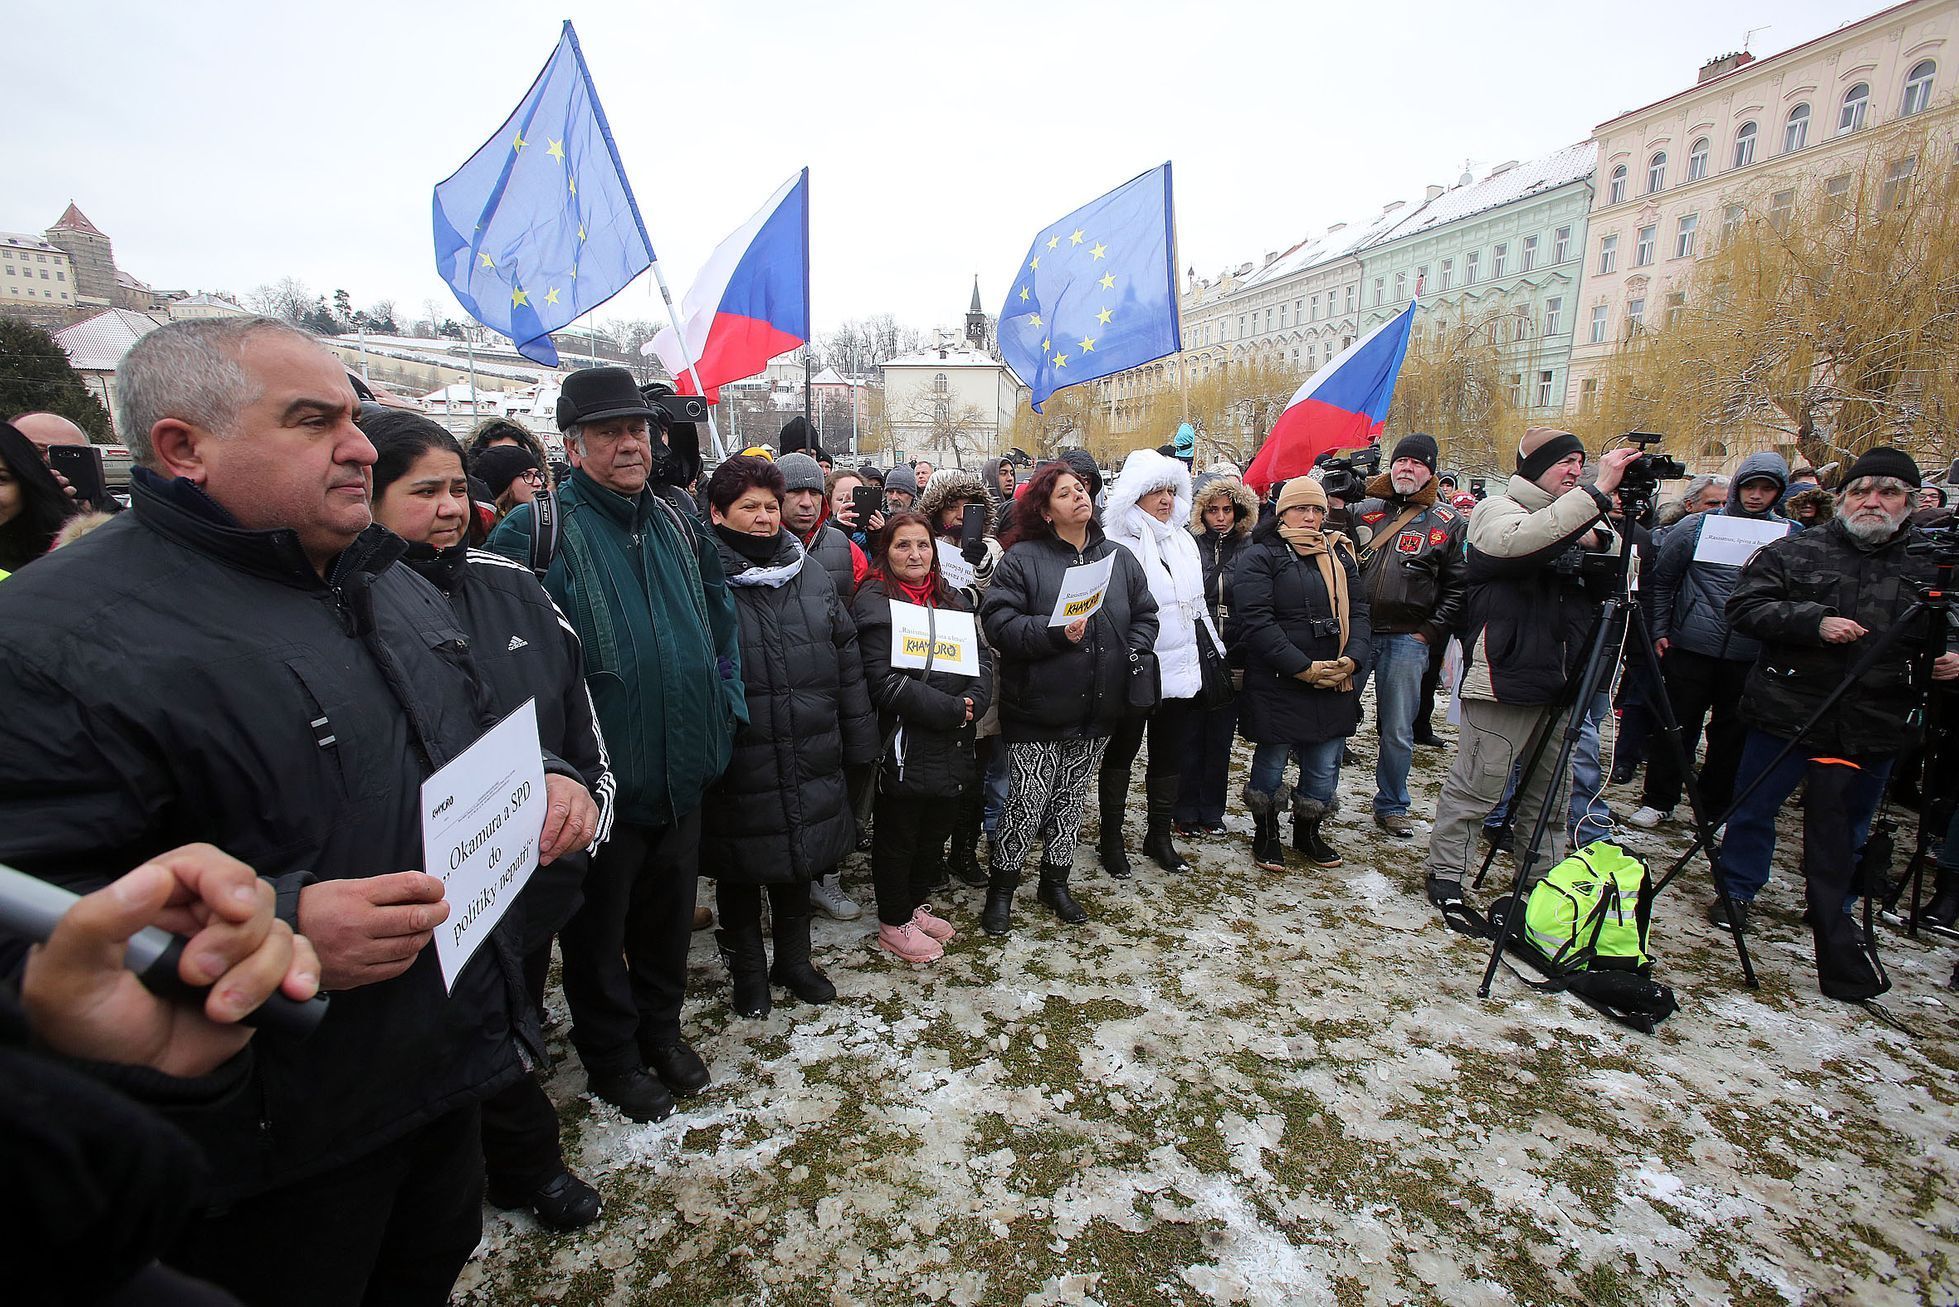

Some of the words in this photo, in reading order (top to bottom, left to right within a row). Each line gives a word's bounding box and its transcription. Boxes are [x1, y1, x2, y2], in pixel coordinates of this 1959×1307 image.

[508, 640, 529, 651] adidas
[504, 806, 510, 821] a
[511, 780, 531, 813] SPD
[488, 846, 502, 870] do
[453, 883, 498, 947] politiky
